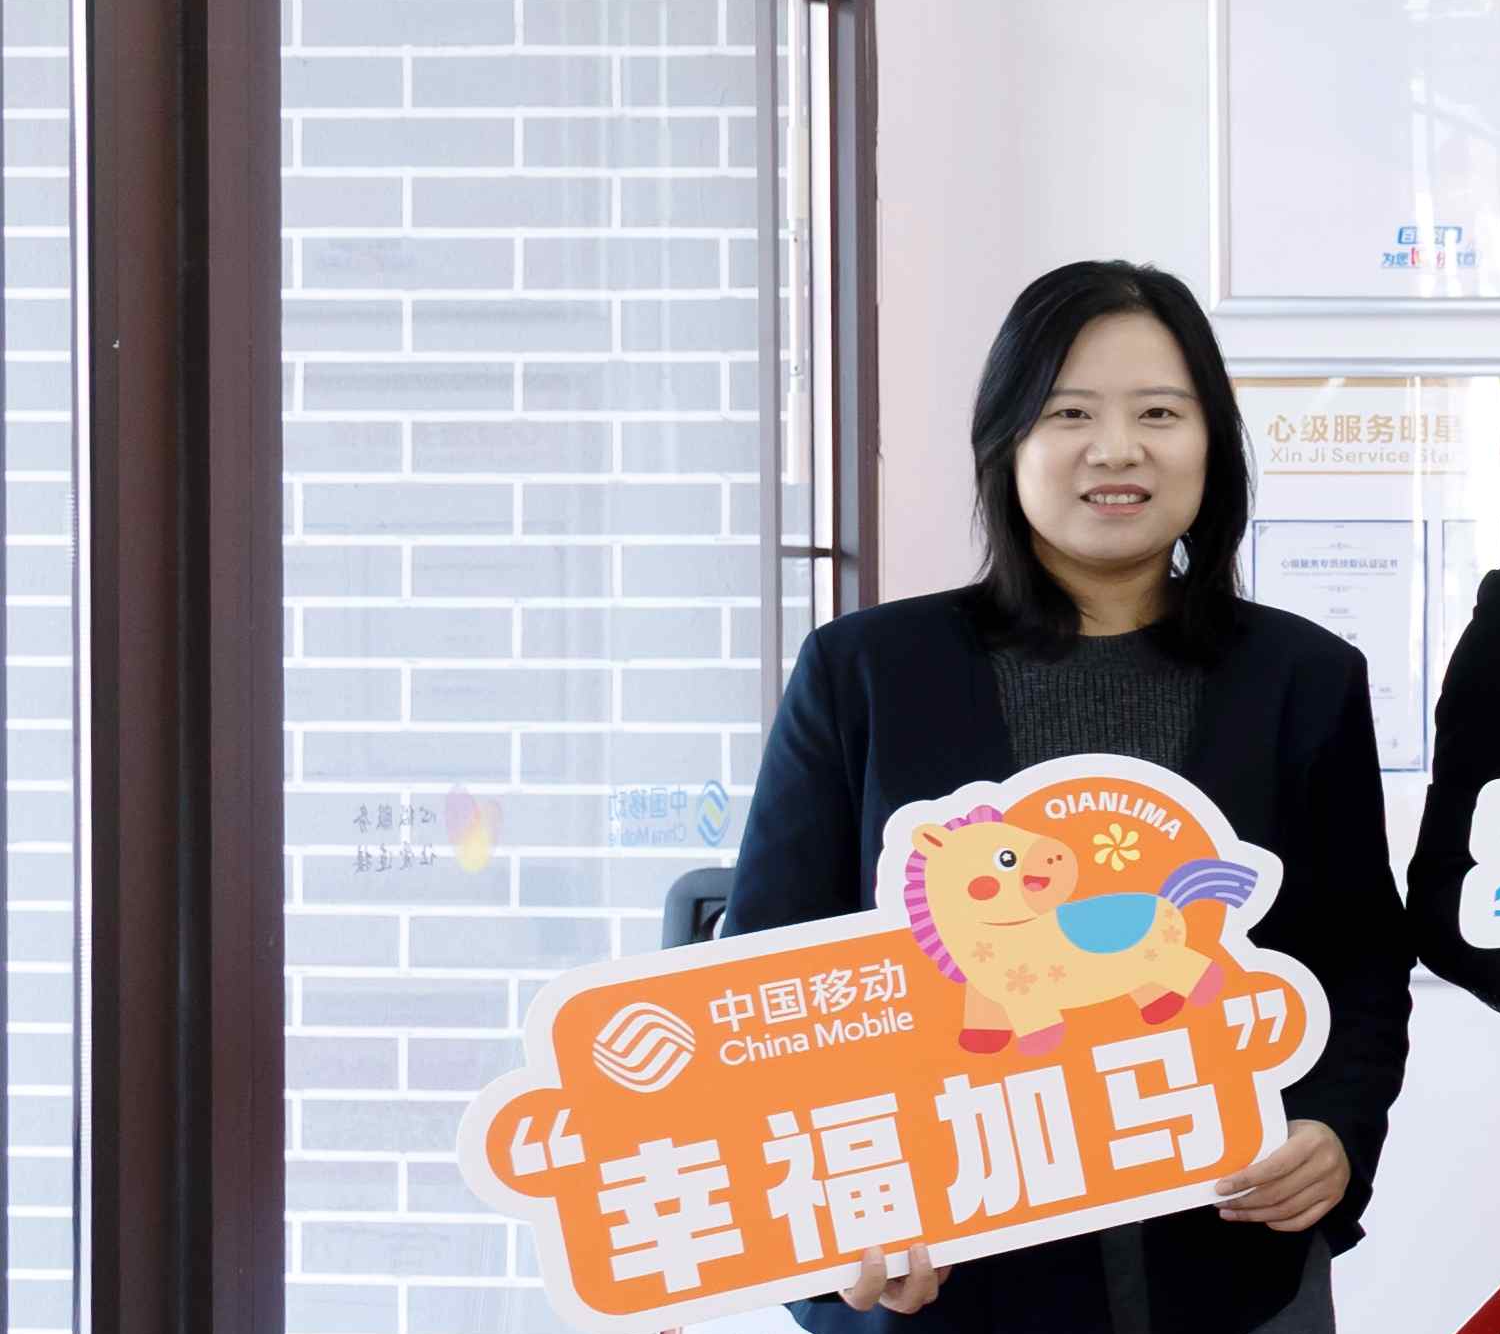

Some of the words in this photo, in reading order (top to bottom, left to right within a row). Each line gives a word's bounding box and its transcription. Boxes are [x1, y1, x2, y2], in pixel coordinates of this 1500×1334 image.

[1270, 447, 1304, 464] Xin
[1333, 447, 1410, 464] Service
[1043, 790, 1186, 842] QIANLIMA
[709, 958, 908, 1034] 中国移动
[719, 1030, 810, 1069] China
[816, 1005, 915, 1051] Mobile
